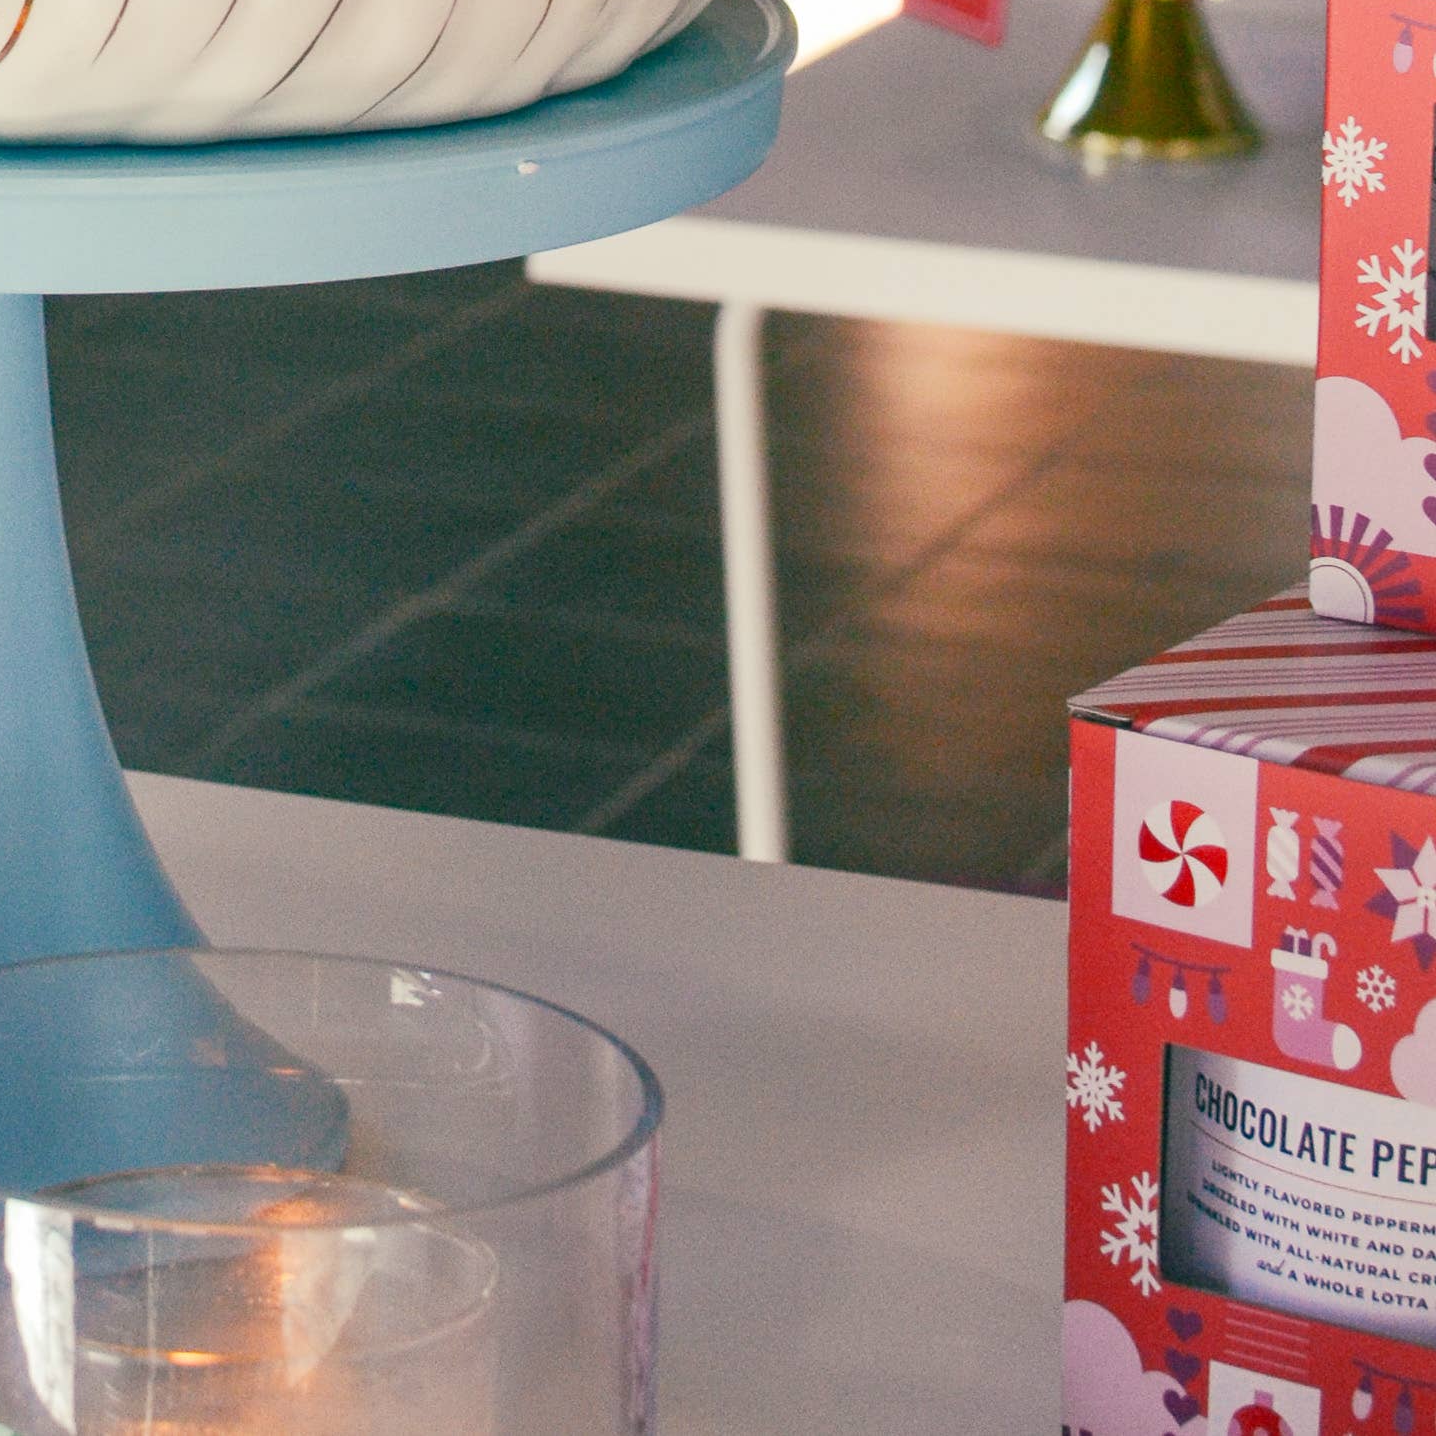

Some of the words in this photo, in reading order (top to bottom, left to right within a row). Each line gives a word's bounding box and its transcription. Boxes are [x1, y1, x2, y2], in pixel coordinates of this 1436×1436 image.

[1194, 1071, 1358, 1173] CHOCOLATE
[1211, 1158, 1259, 1191] LIGHTLY
[1264, 1184, 1347, 1220] FLAVORED
[1244, 1225, 1282, 1250] WITH
[1286, 1243, 1402, 1282] ALL-NATURAL
[1262, 1208, 1301, 1233] WITH
[1306, 1225, 1361, 1249] WHITE
[1365, 1239, 1406, 1257] AND
[1287, 1269, 1299, 1282] A
[1303, 1271, 1365, 1300] WHOLE
[1370, 1289, 1430, 1311] LOTTA
